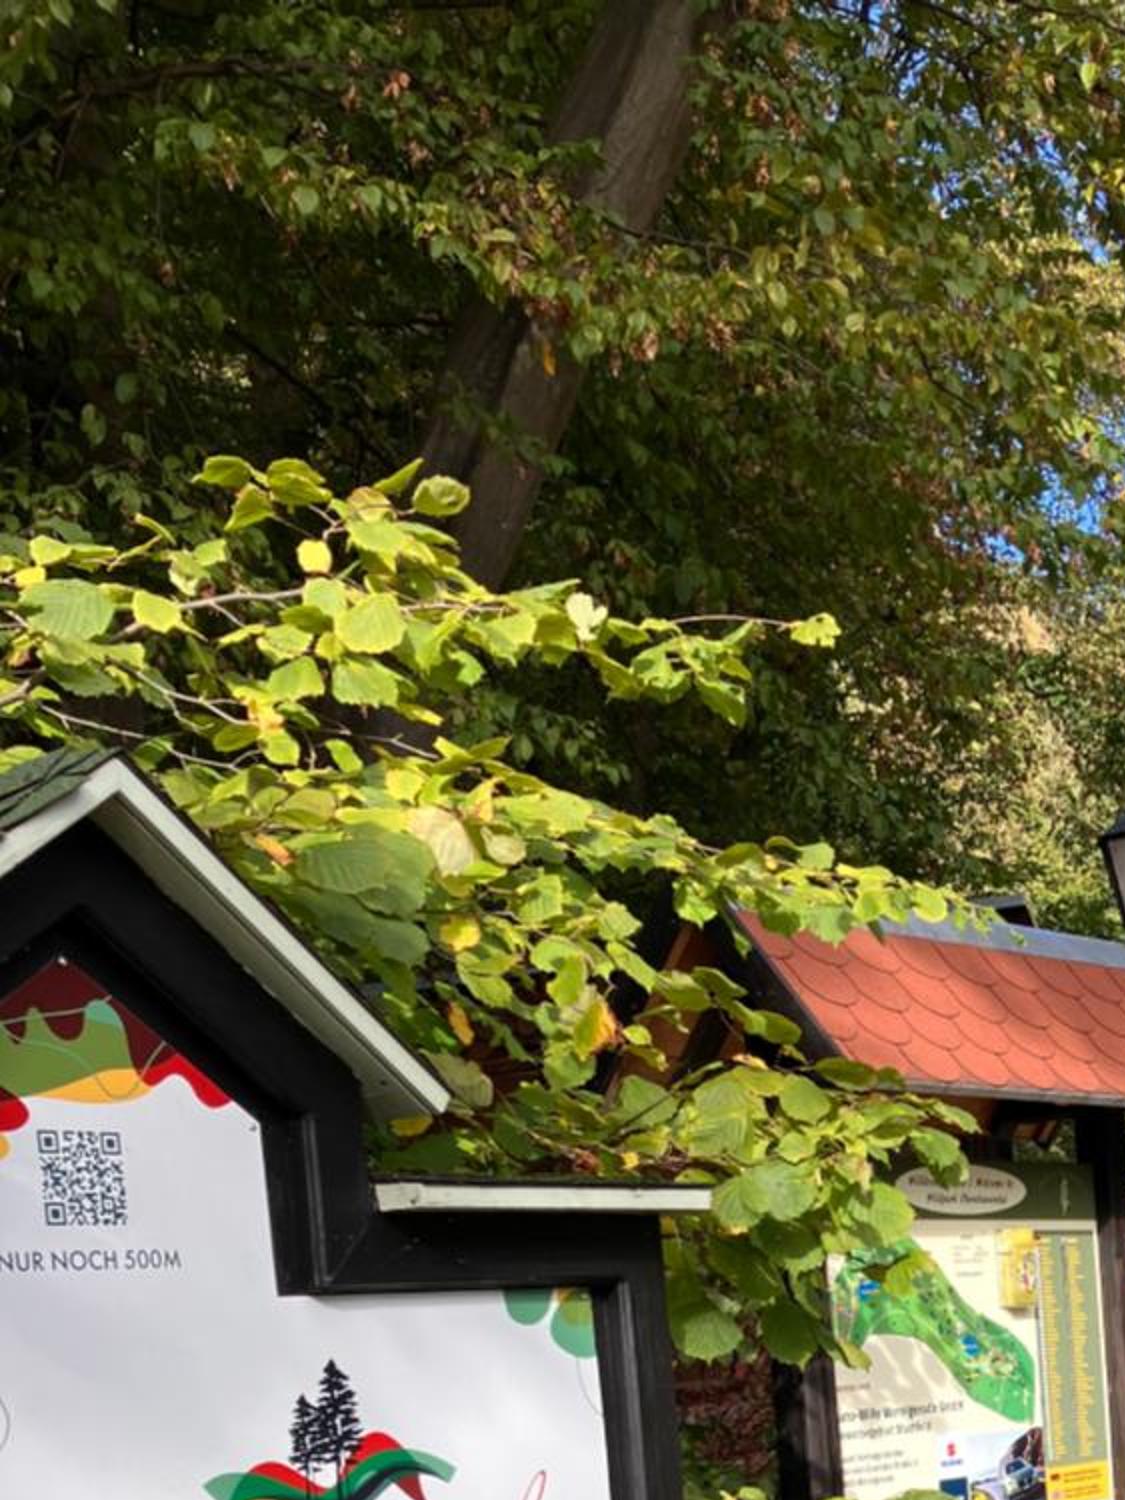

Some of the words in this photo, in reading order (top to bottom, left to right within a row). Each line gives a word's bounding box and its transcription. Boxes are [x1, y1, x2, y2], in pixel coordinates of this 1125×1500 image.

[0, 1252, 44, 1272] NUR
[51, 1250, 118, 1271] NOCH
[125, 1249, 182, 1269] 500M
